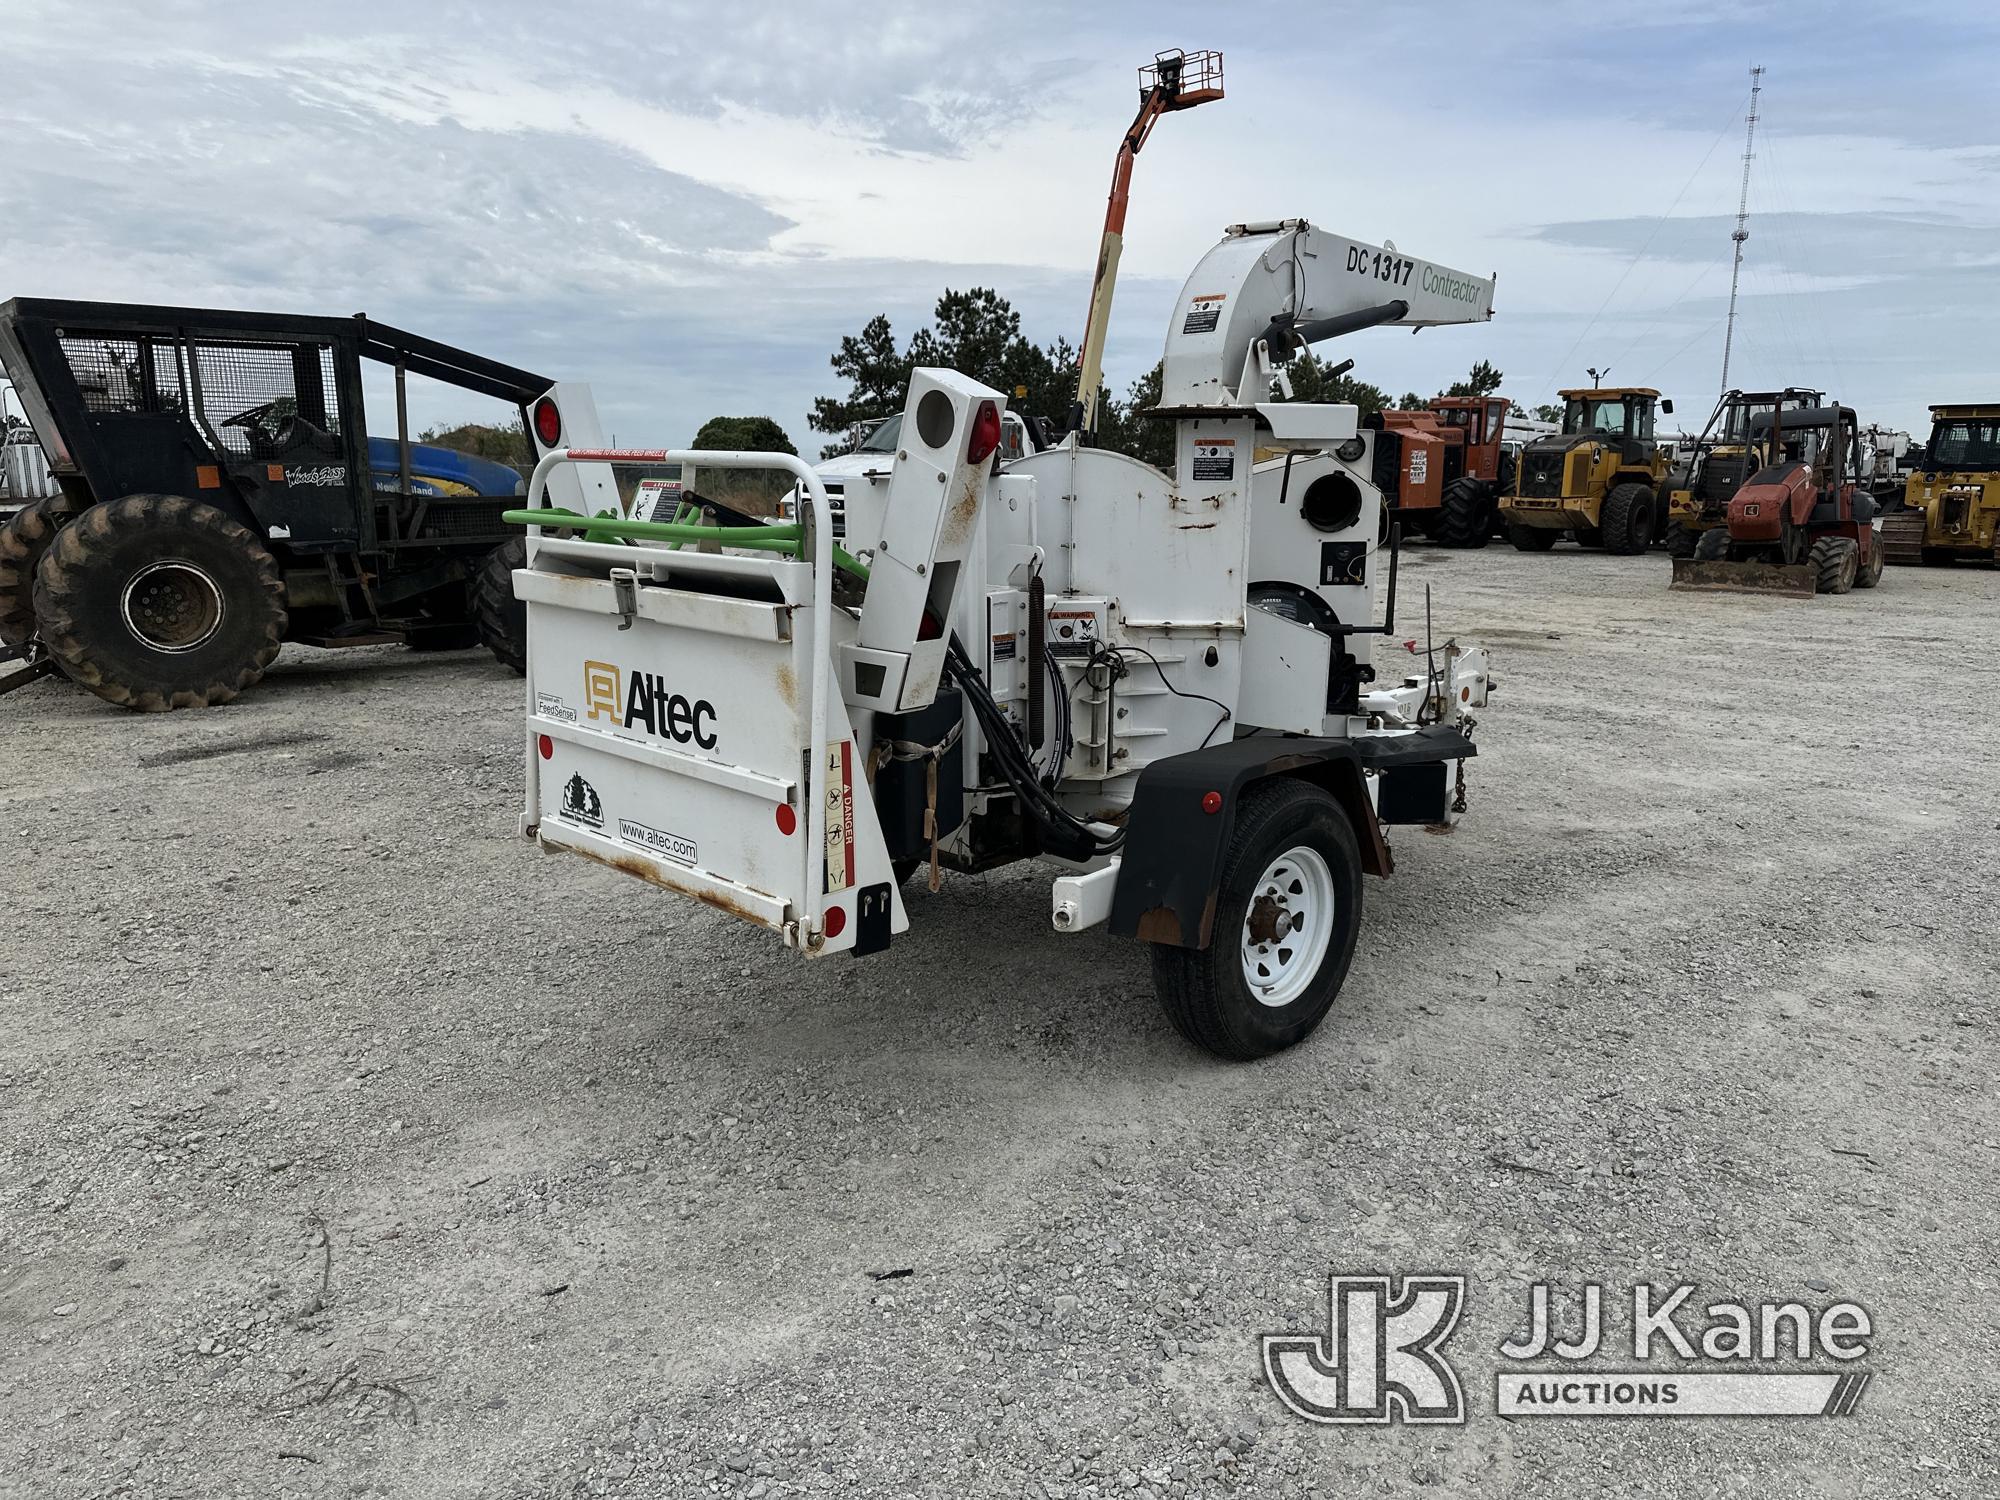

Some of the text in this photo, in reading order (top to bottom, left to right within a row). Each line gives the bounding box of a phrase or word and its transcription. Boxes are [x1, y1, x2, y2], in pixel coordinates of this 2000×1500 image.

[1346, 245, 1414, 286] DC 1317
[1422, 265, 1481, 304] Contractor
[539, 701, 574, 720] FeedSense
[624, 670, 718, 751] Altec
[621, 822, 696, 859] www.altec.com
[843, 796, 853, 845] DANGER
